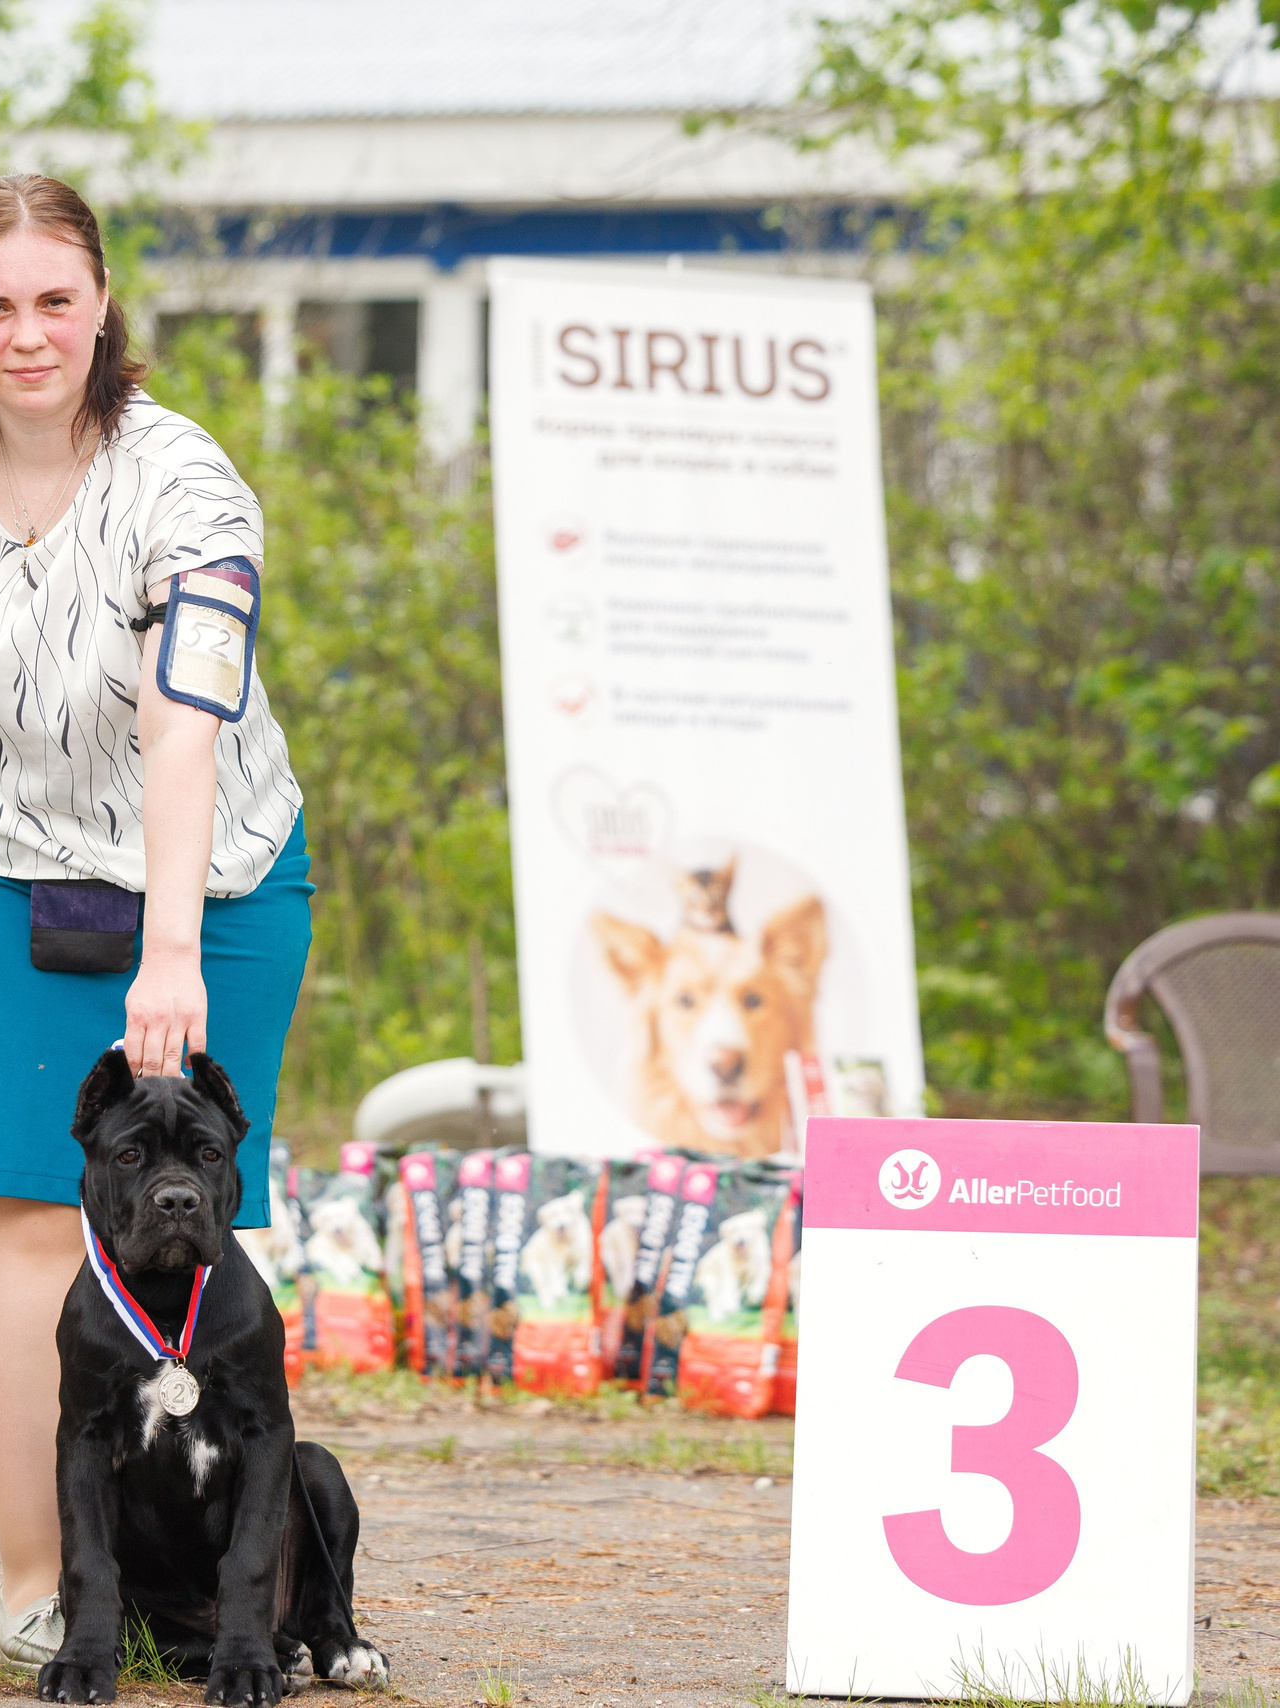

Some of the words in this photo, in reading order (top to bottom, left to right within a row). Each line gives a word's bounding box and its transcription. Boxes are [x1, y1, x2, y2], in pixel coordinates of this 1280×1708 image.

[557, 323, 832, 403] SIRIUS
[181, 620, 231, 660] 52
[948, 1178, 1121, 1208] AllerPetfood
[172, 1383, 186, 1404] 2
[882, 1305, 1081, 1606] 3
